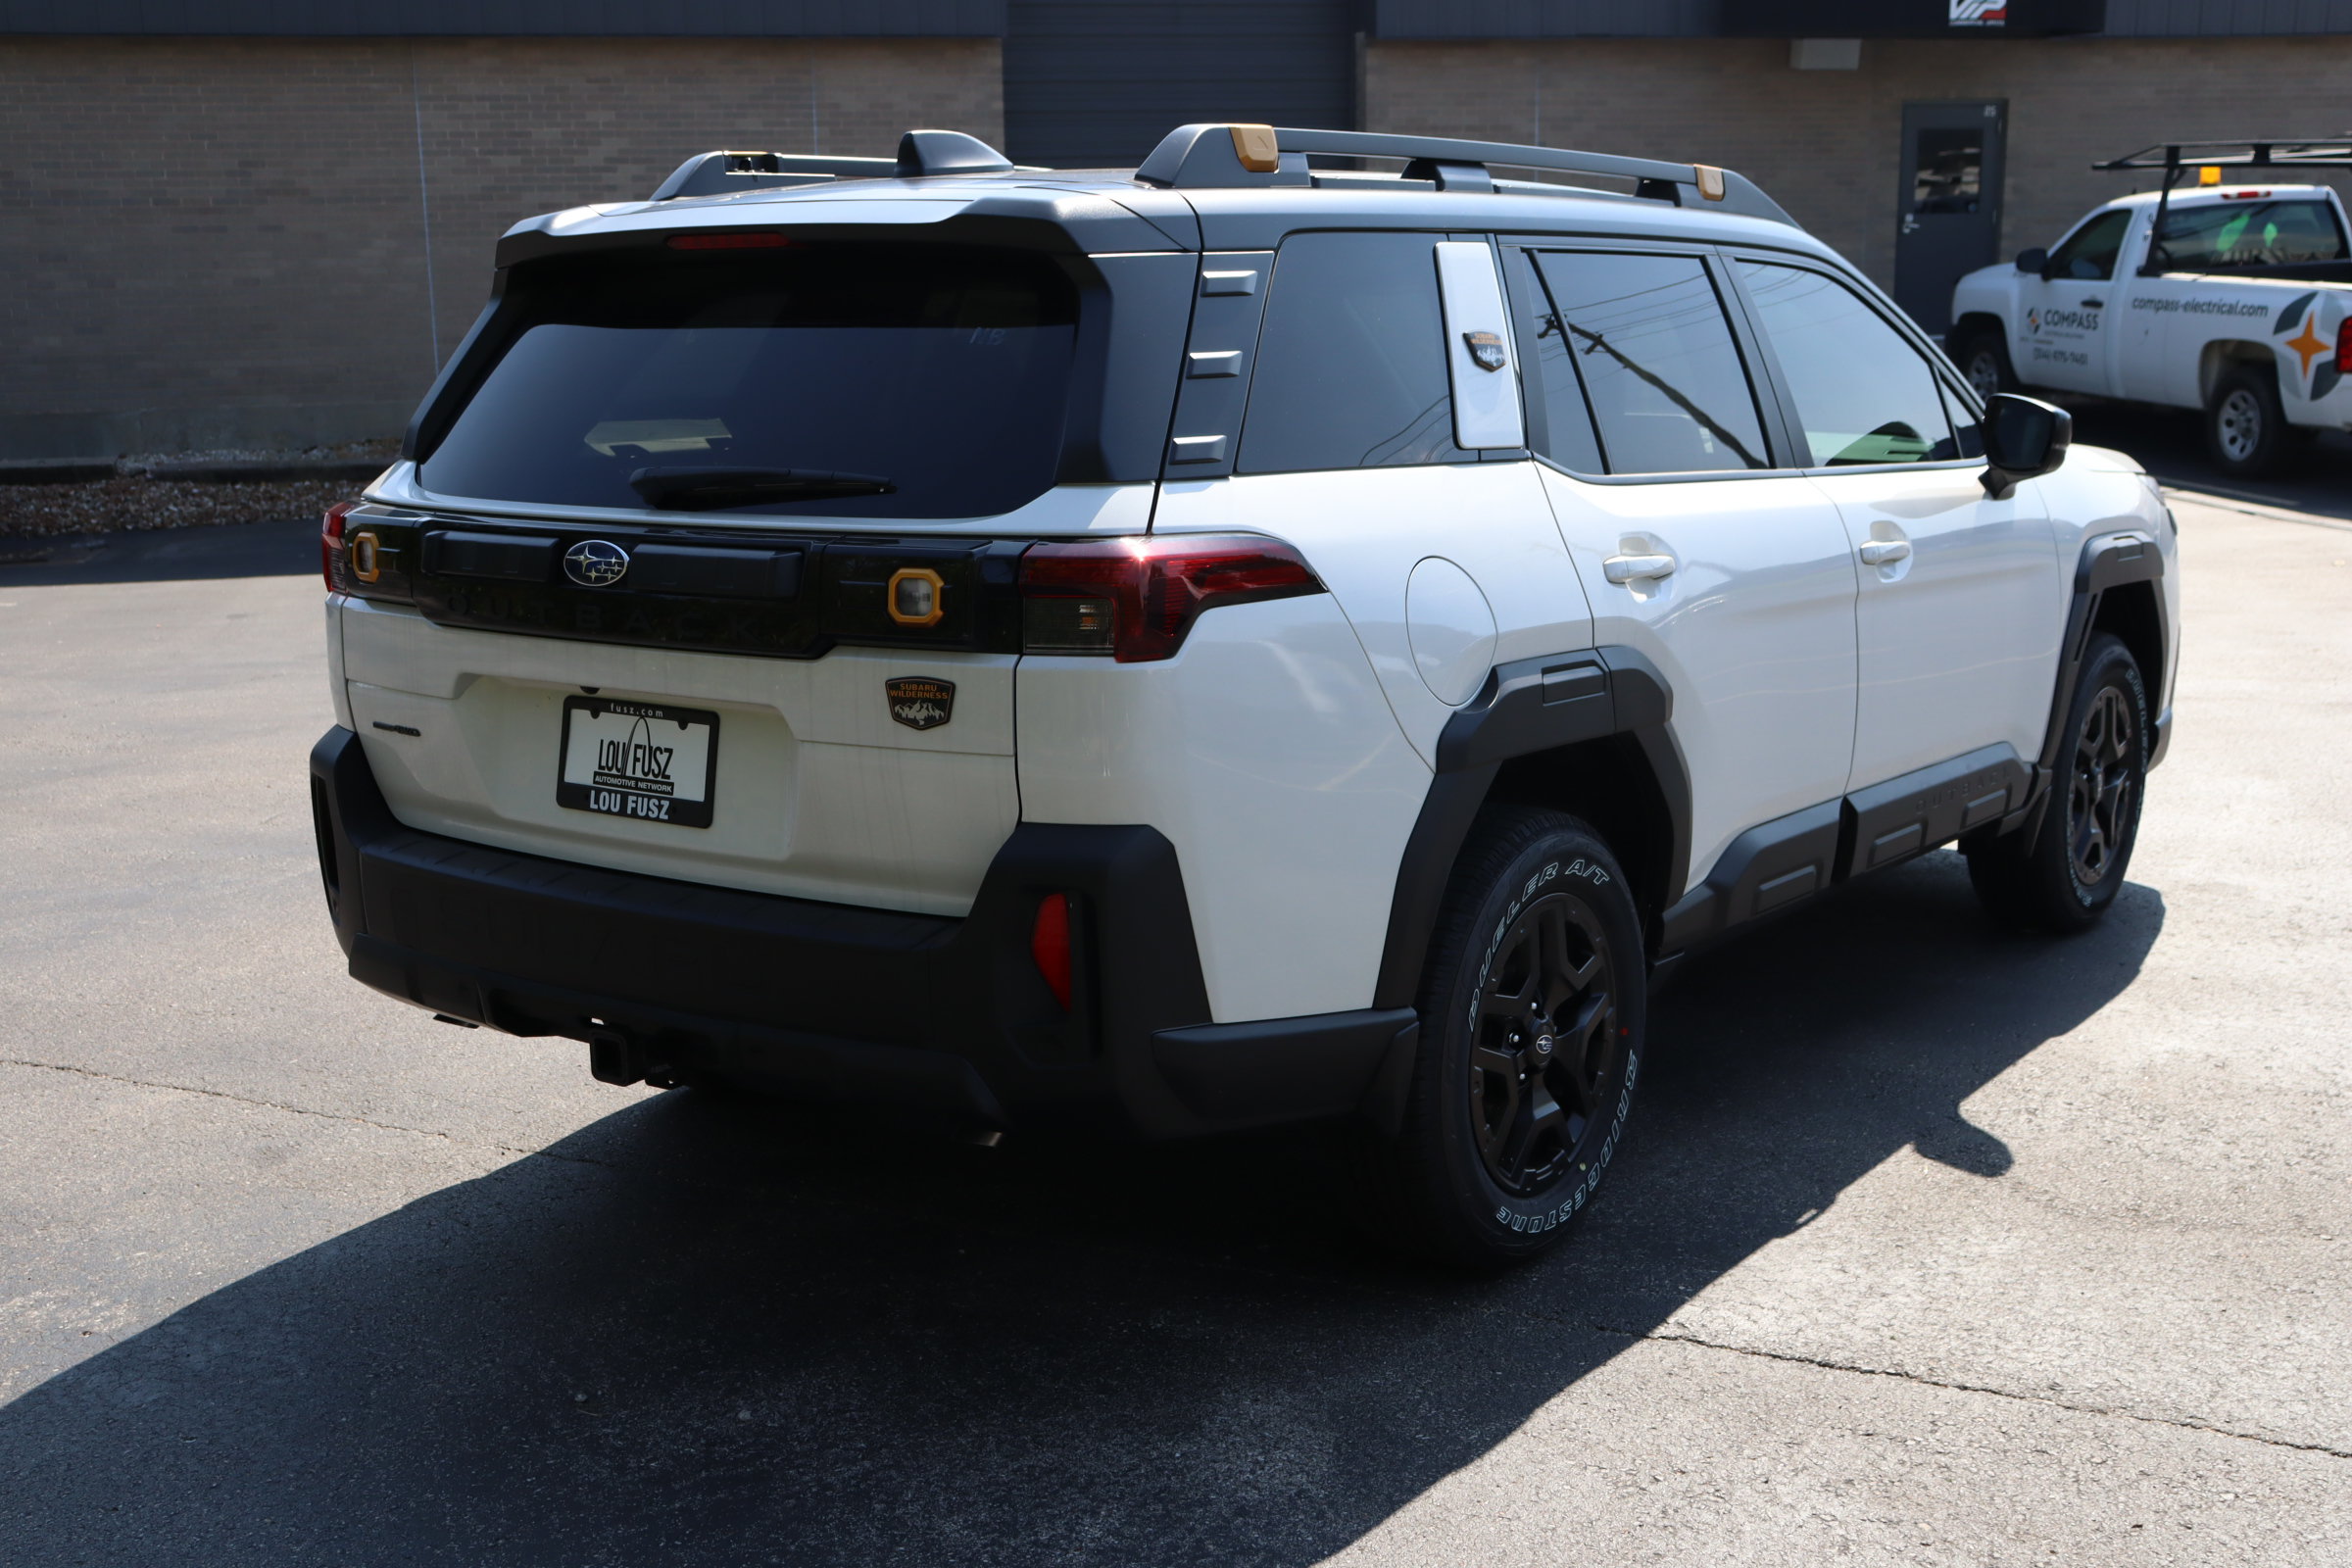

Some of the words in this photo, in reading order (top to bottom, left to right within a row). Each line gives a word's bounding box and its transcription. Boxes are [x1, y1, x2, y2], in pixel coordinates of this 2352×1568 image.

[2132, 296, 2269, 318] compass-electrical.com
[2044, 309, 2098, 330] COMPASS
[446, 594, 762, 643] OUTBACK
[890, 690, 949, 700] WILDERNESS
[900, 683, 937, 692] SUBARU
[610, 703, 664, 717] fusz.com
[598, 739, 626, 773] LOU
[632, 743, 674, 780] FUSZ
[594, 775, 636, 788] AUTOMOTIVE
[637, 781, 672, 793] NETWORK
[590, 790, 621, 812] LOU
[626, 795, 670, 820] FUSZ
[1469, 861, 1559, 1032] DUELER
[1565, 858, 1610, 885] A/T
[1496, 1049, 1638, 1233] BRIDGESTONE
